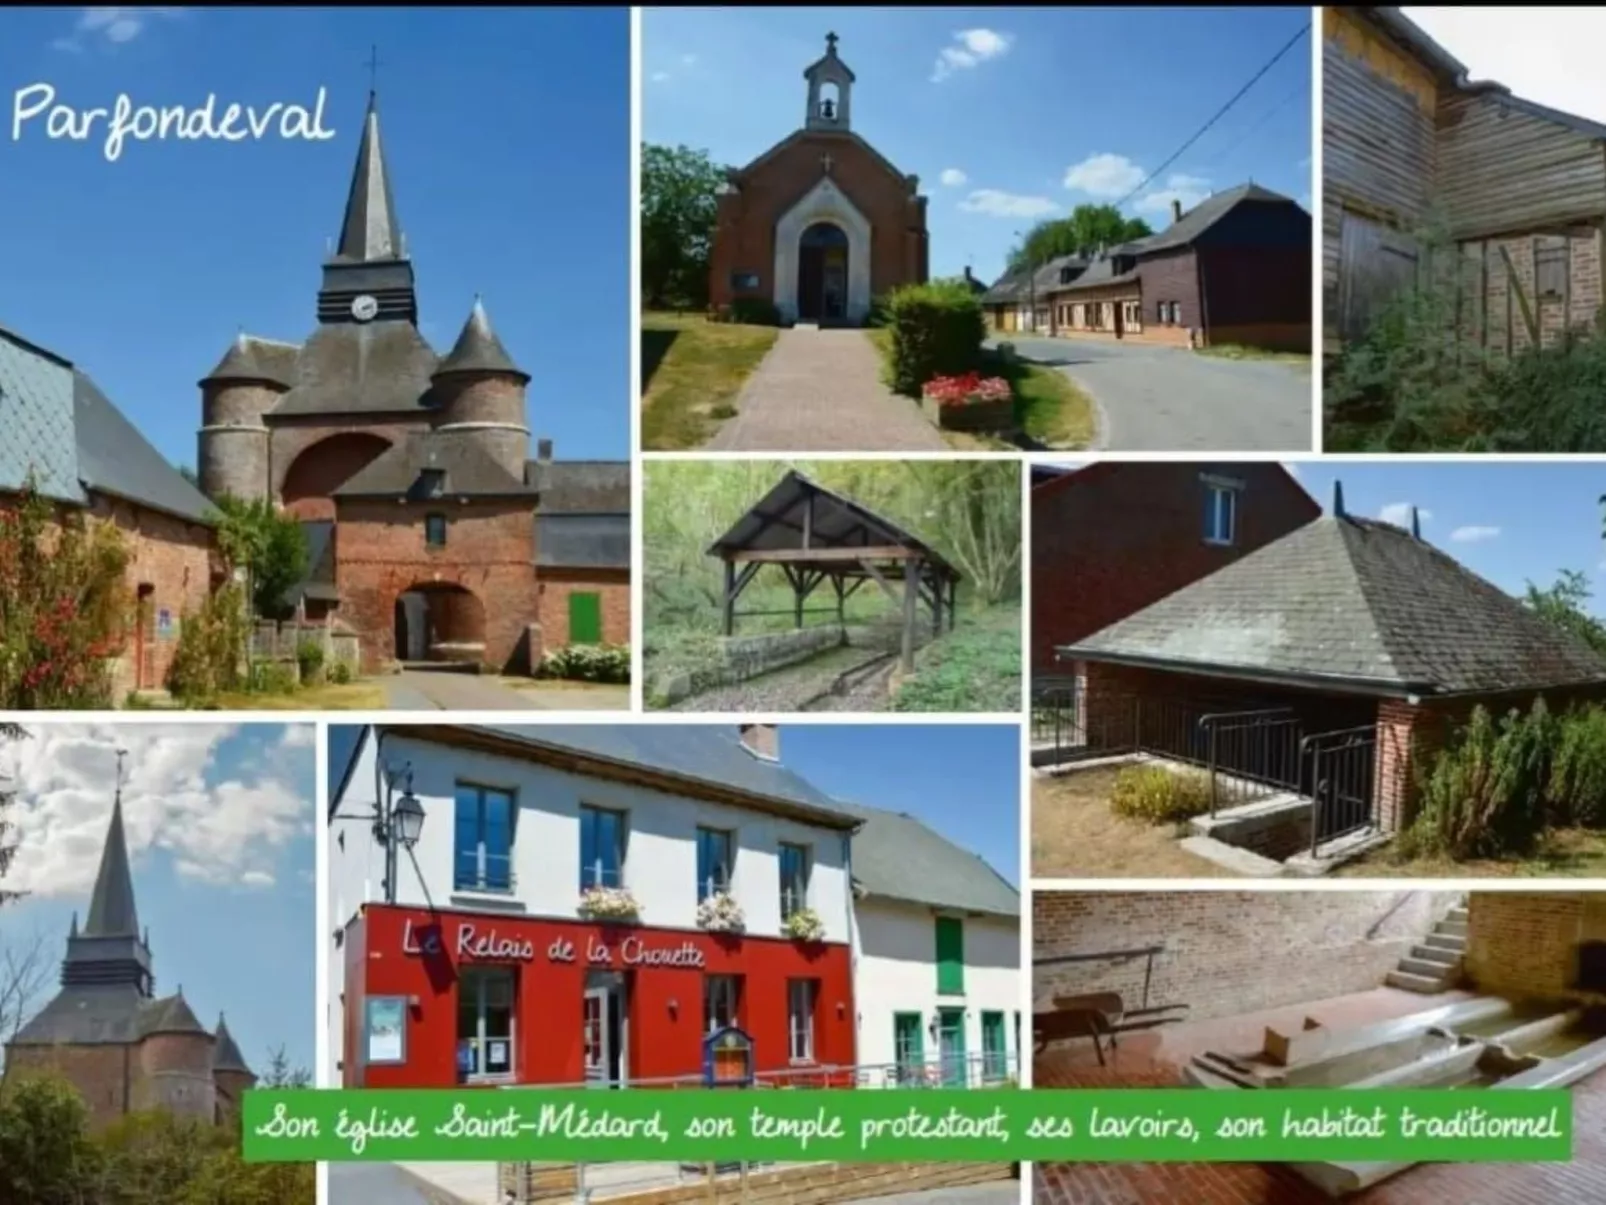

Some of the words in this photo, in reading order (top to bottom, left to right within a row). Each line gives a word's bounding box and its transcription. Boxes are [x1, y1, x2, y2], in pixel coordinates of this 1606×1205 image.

[403, 918, 440, 955] Le
[457, 923, 533, 959] Relais
[547, 935, 576, 962] de
[586, 936, 612, 962] la
[621, 935, 706, 968] Chouette
